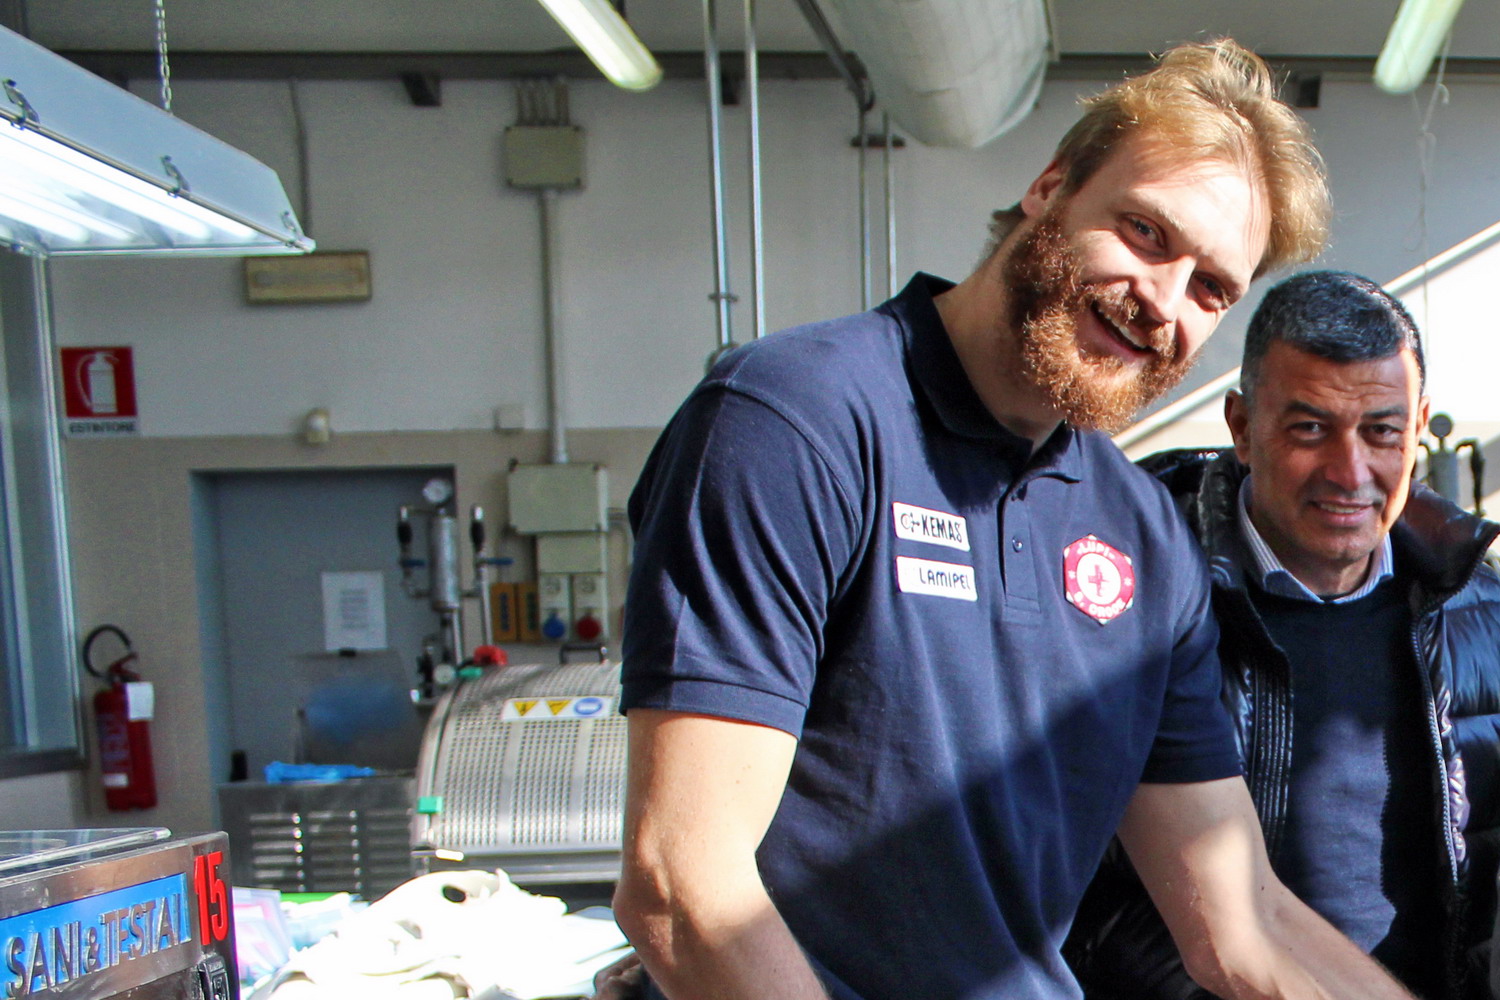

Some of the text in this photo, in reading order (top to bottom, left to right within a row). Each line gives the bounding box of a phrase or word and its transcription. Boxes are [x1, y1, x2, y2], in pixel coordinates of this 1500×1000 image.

[921, 513, 962, 543] KEMAS
[919, 567, 971, 591] LAMIPEL
[194, 851, 229, 945] 15
[6, 893, 182, 1000] SANI&TESTAI
